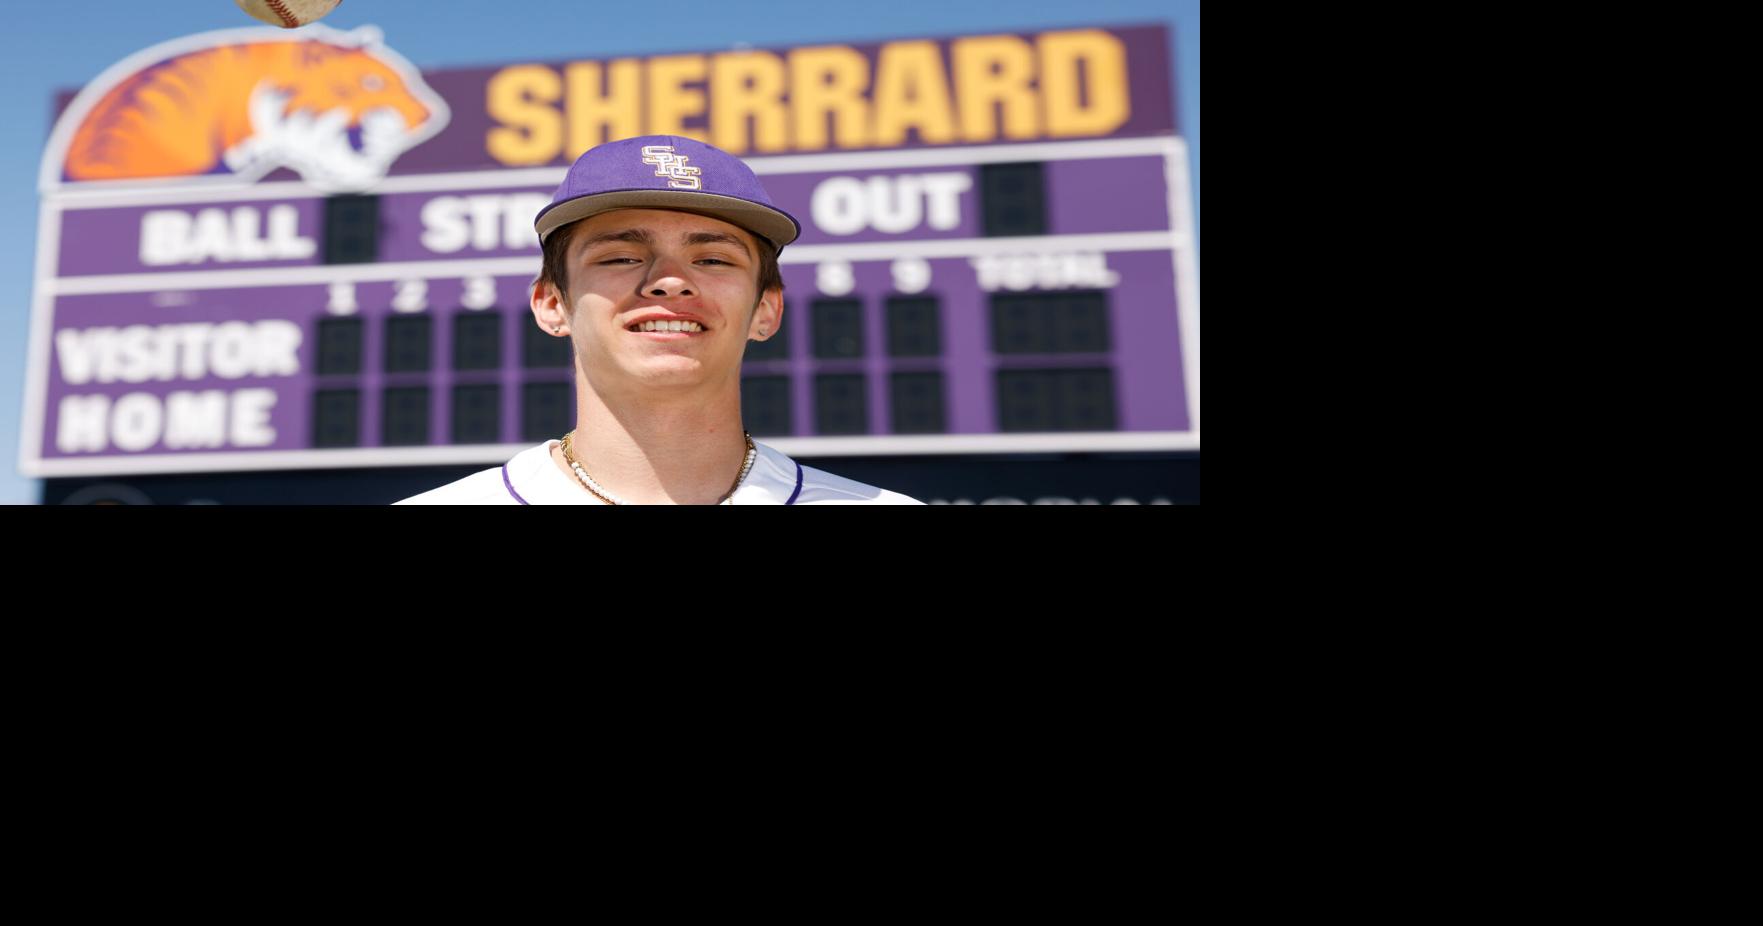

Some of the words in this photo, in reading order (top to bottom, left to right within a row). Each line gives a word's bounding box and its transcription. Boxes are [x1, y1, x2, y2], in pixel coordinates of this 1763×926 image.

[485, 28, 1131, 166] SHERRARD
[139, 203, 316, 265] BALL
[420, 193, 552, 253] STR
[810, 172, 971, 235] OUT
[326, 279, 357, 314] 1
[392, 278, 429, 312] 2
[460, 275, 497, 310] 3
[892, 258, 931, 293] 9
[970, 255, 1119, 291] TOTAL
[56, 320, 301, 384] VISITOR
[57, 389, 277, 452] HOME
